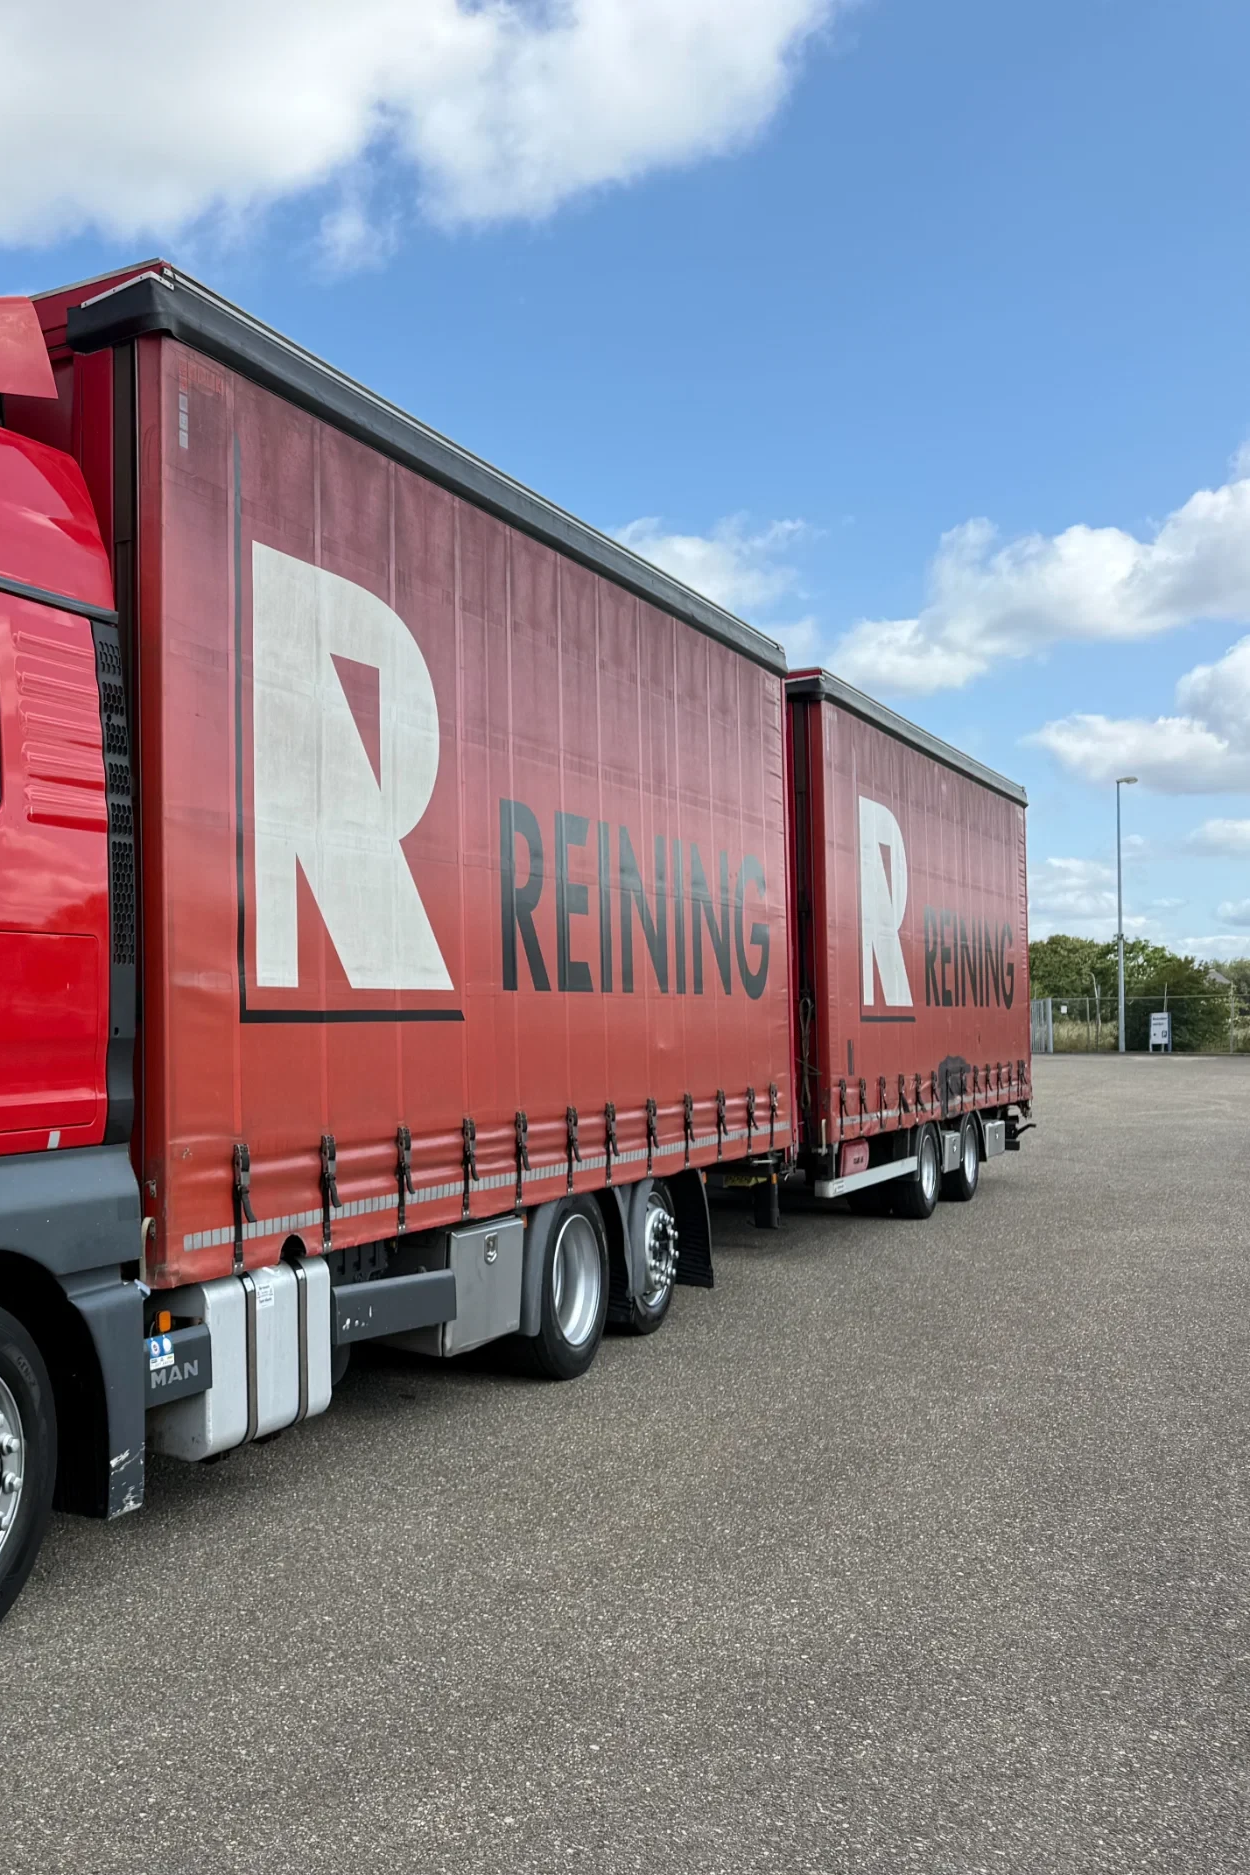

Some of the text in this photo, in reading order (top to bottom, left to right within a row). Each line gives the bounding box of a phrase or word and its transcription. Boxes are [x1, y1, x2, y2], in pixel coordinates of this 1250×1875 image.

[252, 540, 454, 990] R
[500, 797, 770, 1000] REINING
[859, 796, 913, 1007] R
[923, 903, 1014, 1010] REINING
[150, 1360, 199, 1389] MAN
